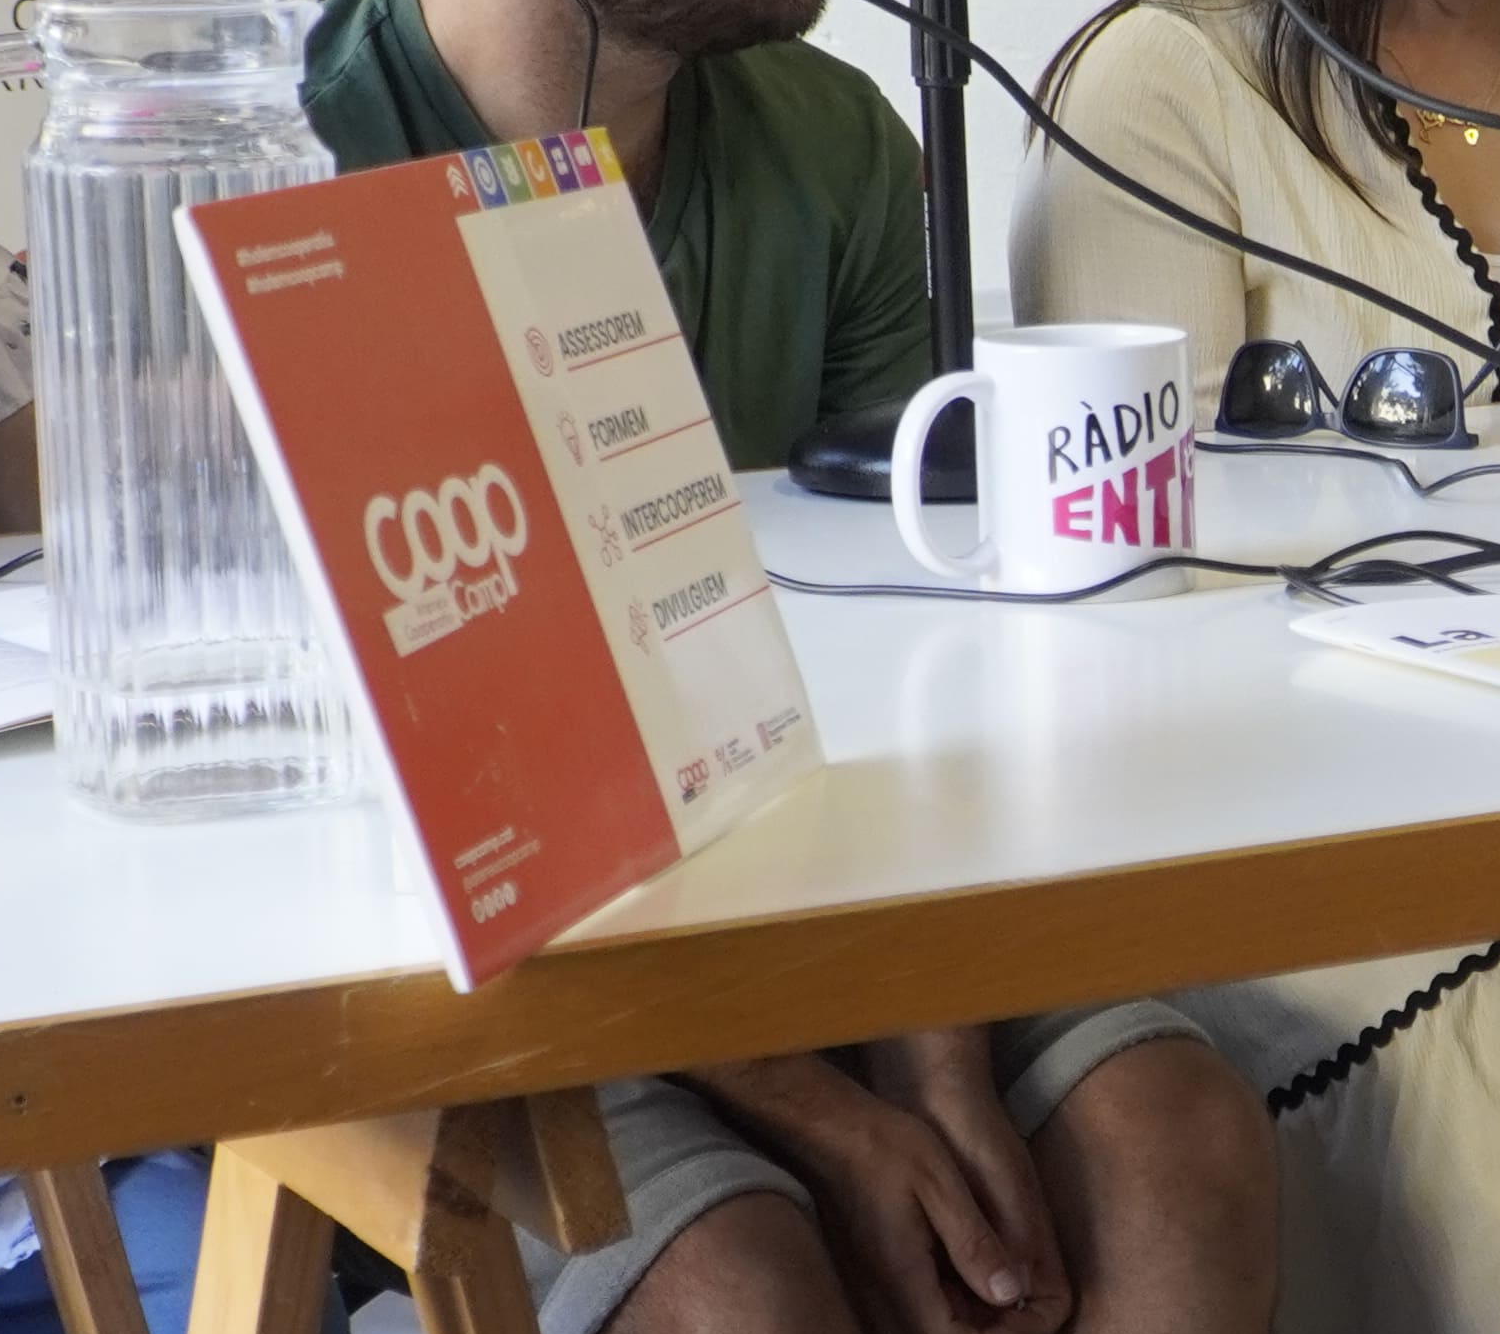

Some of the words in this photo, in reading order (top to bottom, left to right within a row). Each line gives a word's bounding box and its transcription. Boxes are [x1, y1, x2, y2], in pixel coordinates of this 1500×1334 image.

[557, 310, 646, 361] ASSESSOREM
[588, 406, 650, 452] FORMEM
[1048, 380, 1180, 480] RÀDIO
[620, 473, 729, 542] INTERCOOPEREM
[652, 571, 729, 631] DIVULGUEM
[1390, 624, 1495, 650] La
